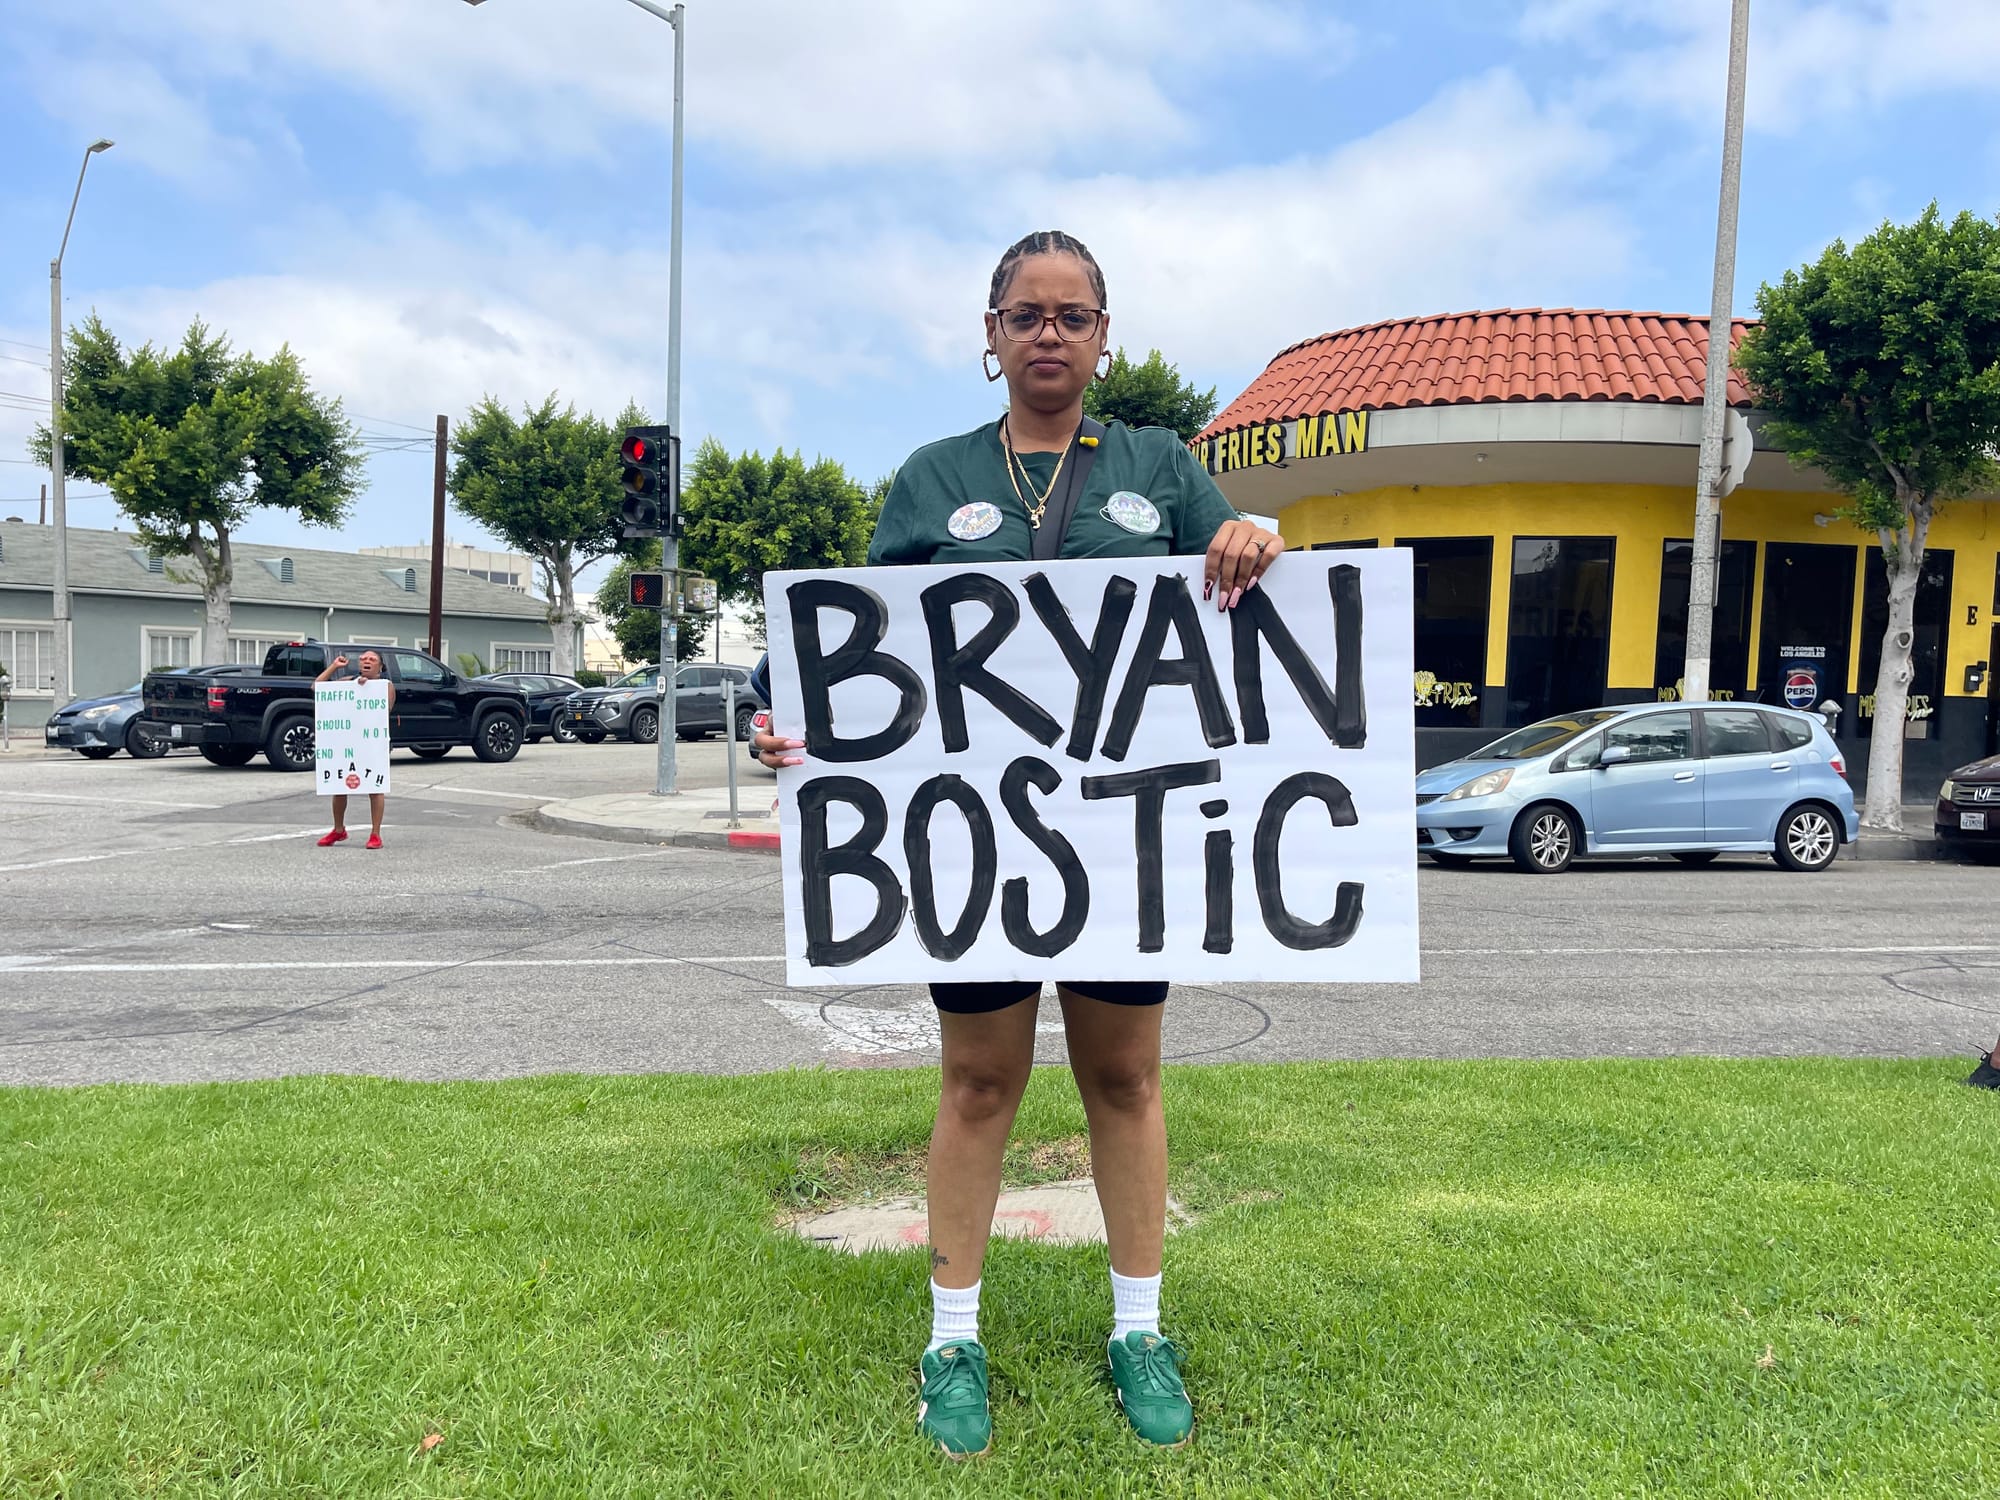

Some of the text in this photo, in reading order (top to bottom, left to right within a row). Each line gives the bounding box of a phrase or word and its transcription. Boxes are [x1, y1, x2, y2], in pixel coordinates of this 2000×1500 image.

[1218, 423, 1284, 473] FRIES
[1296, 410, 1369, 459] MAN
[1966, 605, 1979, 626] E
[786, 563, 1367, 762] BRYAN
[315, 690, 387, 710] TRAFFIC STOPS
[1786, 687, 1815, 696] PEPSI
[1905, 695, 1929, 715] RIES
[316, 719, 388, 739] SHOULD NOT
[316, 747, 354, 760] END IN
[324, 762, 384, 785] DEATH
